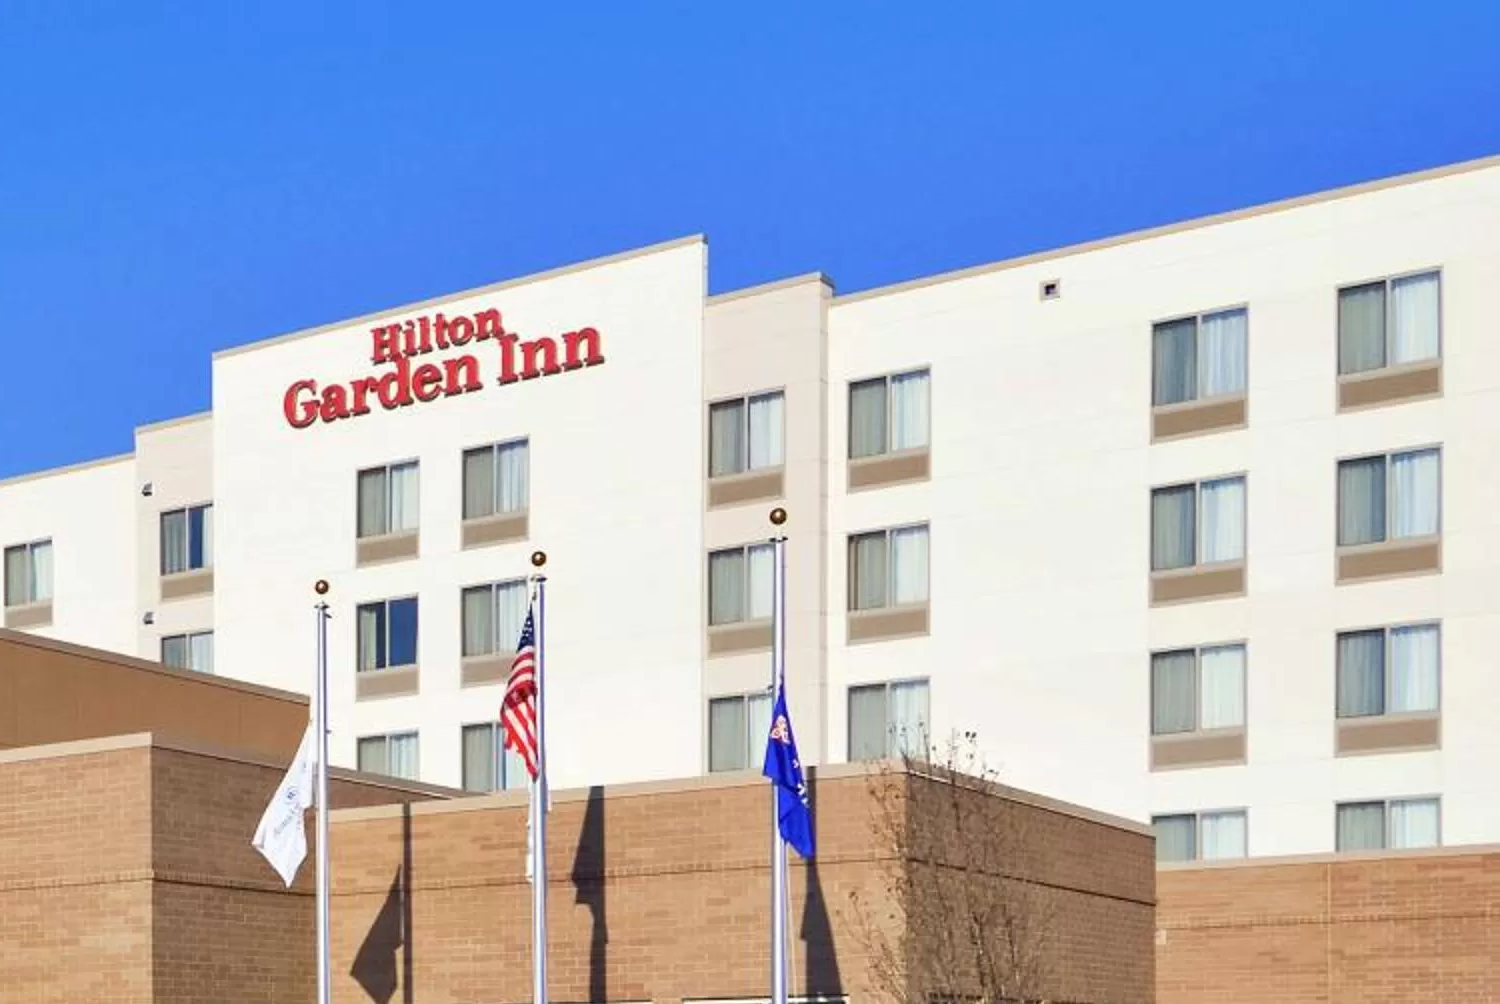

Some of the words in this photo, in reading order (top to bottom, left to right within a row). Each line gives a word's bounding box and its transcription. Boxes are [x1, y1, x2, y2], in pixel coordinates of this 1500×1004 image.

[370, 307, 505, 366] Hilton
[283, 353, 483, 429] Garden
[497, 326, 605, 385] Inn
